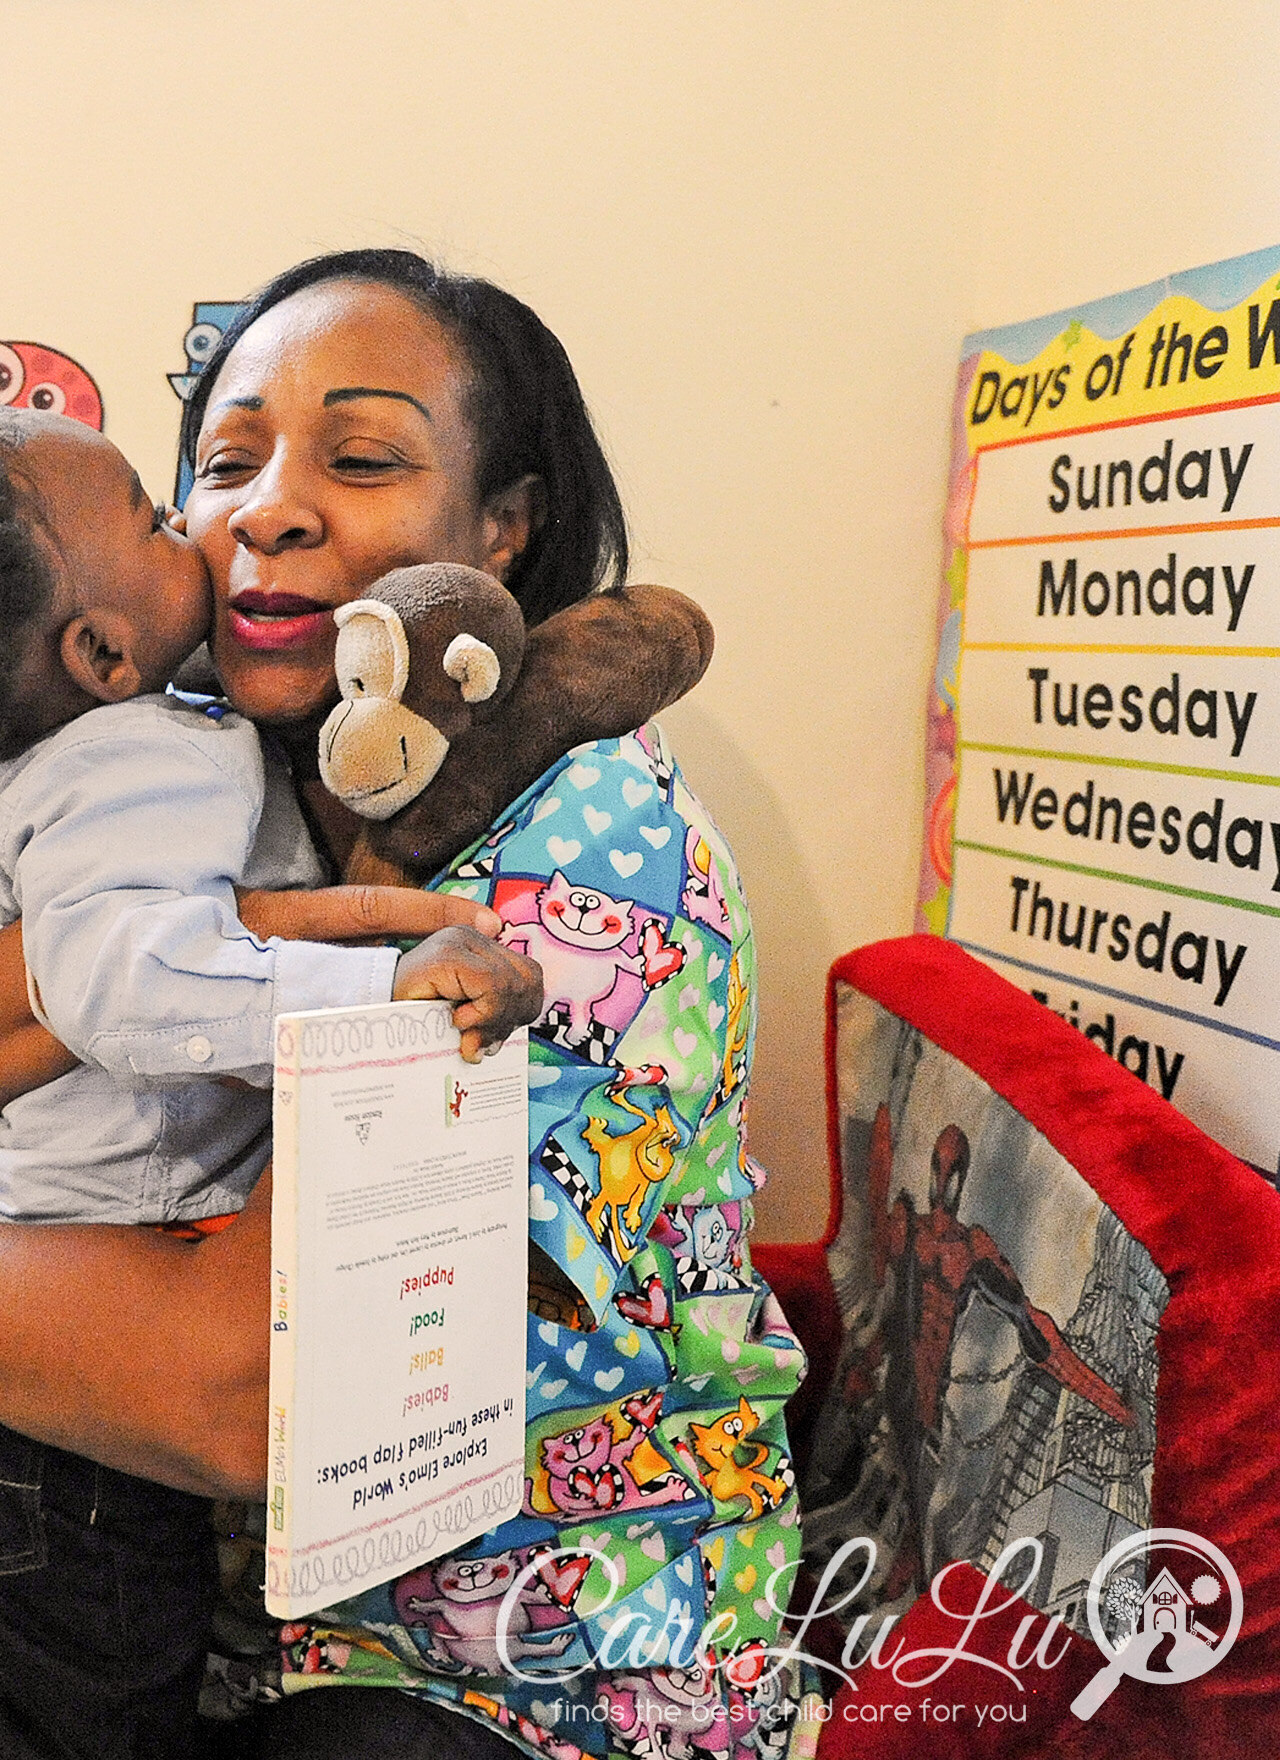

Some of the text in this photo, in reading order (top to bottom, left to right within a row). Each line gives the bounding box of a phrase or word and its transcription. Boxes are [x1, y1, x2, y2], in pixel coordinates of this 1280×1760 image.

[971, 364, 1071, 427] Days
[1085, 333, 1135, 401] of
[1144, 321, 1228, 389] the
[1048, 438, 1254, 514] Sunday
[1037, 553, 1256, 632] Monday
[1027, 668, 1258, 757] Tuesday
[992, 768, 1280, 892] Wednesda
[1010, 876, 1248, 1007] Thursday
[400, 1265, 455, 1300] Puppies!
[409, 1307, 445, 1336] Food!
[409, 1347, 444, 1375] Balls!
[402, 1384, 449, 1417] Babies!
[317, 1398, 514, 1484] in these fun-filled flap books:
[352, 1437, 488, 1510] Explore Elmo's World
